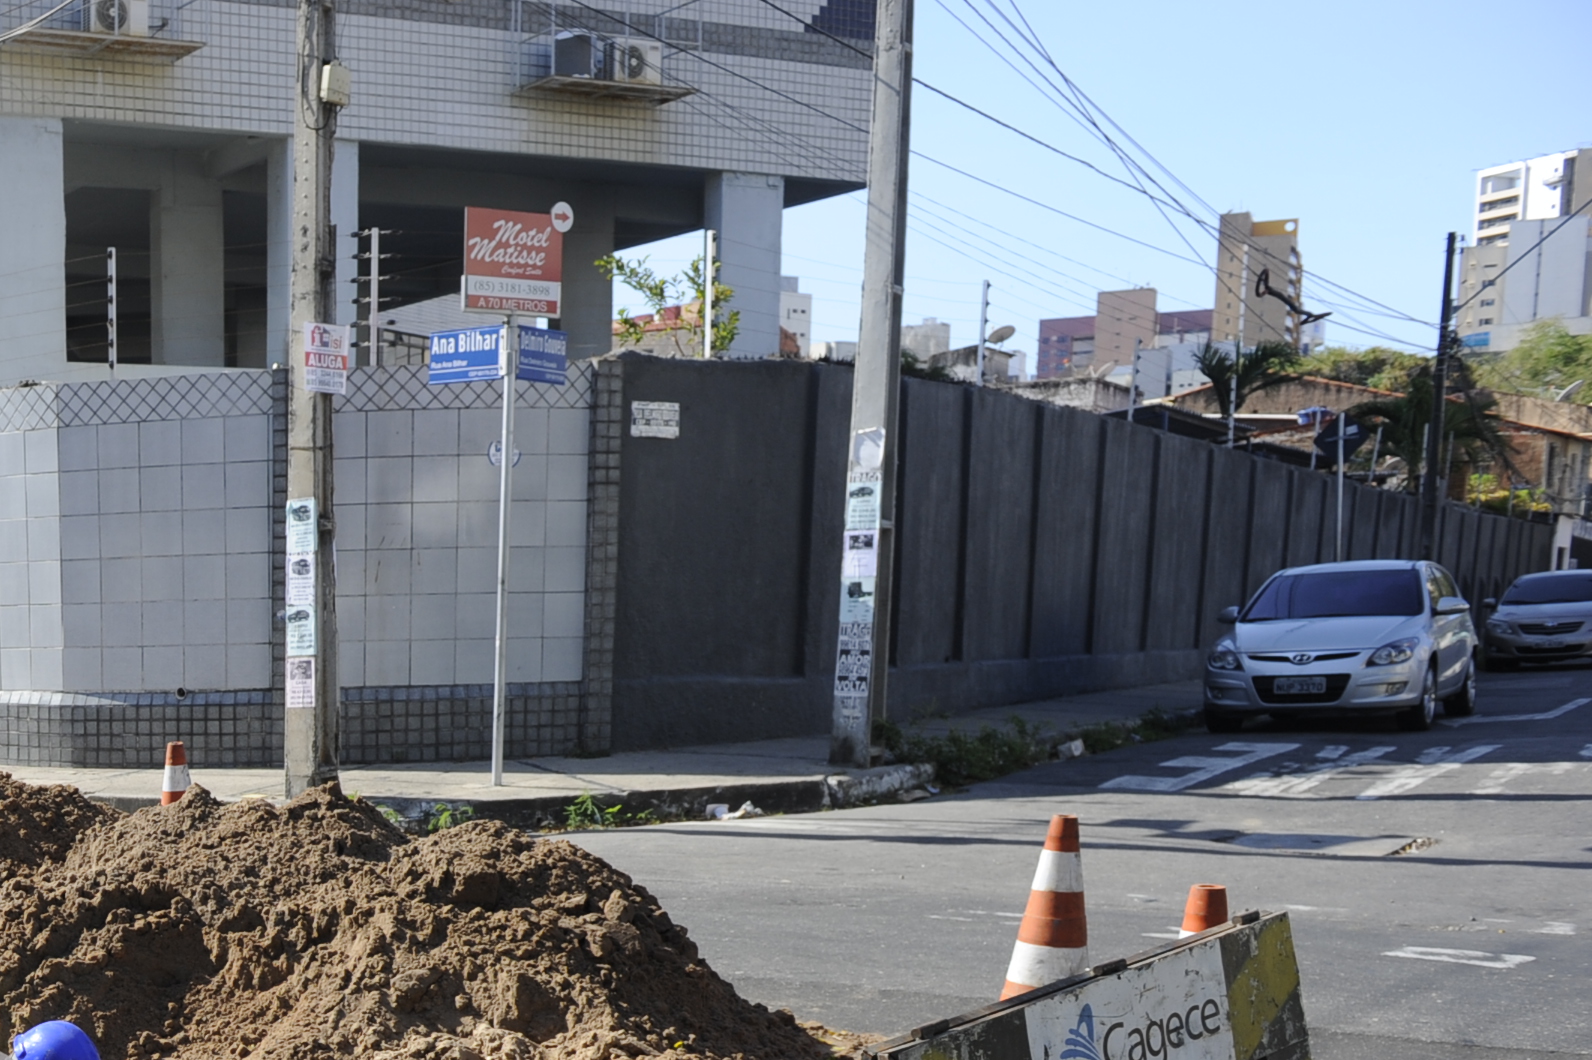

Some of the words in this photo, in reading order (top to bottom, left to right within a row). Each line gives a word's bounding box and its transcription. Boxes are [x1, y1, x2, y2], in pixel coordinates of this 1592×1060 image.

[493, 219, 552, 247] Motel
[468, 236, 546, 266] Matisse
[473, 280, 495, 293] (85)
[477, 297, 487, 308] A
[488, 298, 501, 309] 70
[502, 300, 548, 312] METROS
[431, 336, 456, 355] Ana
[458, 331, 498, 353] Bilhar
[308, 353, 343, 369] ALUGA
[836, 680, 867, 692] VOLTA
